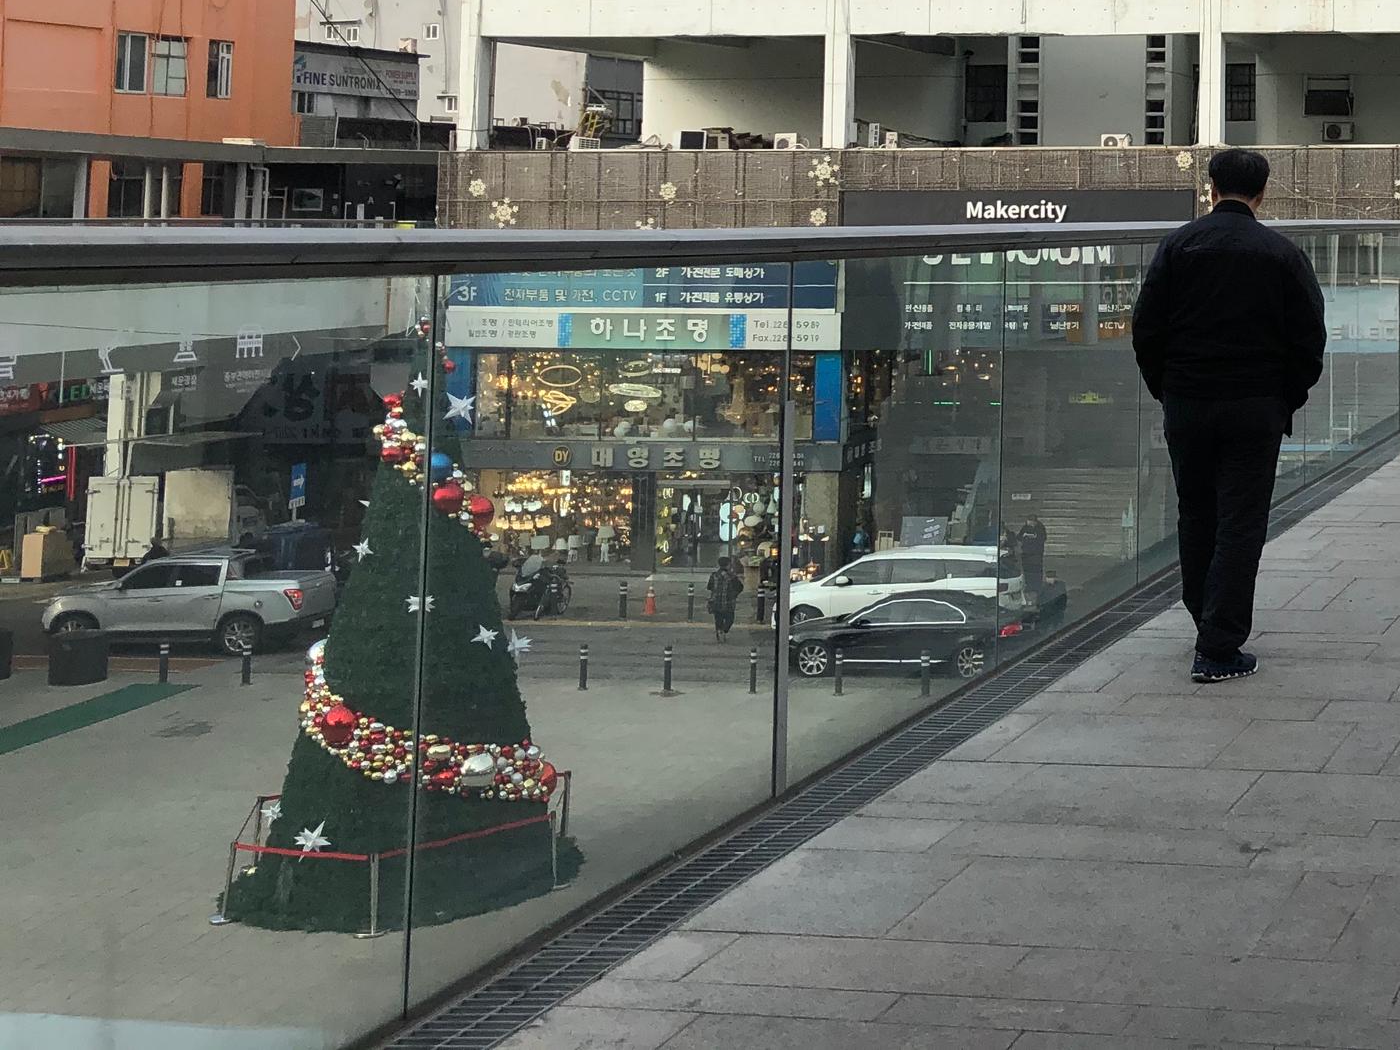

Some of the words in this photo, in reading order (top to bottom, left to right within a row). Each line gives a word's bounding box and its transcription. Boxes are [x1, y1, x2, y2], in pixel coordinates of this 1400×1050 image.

[303, 71, 327, 86] FINE
[966, 199, 1068, 223] Makercity
[655, 266, 670, 278] 2F
[504, 288, 549, 302] 전자부품
[555, 288, 568, 302] 및
[602, 289, 637, 301] CCTV
[589, 317, 710, 342] 하나조명
[554, 451, 569, 463] DY
[591, 446, 721, 469] 대영조명
